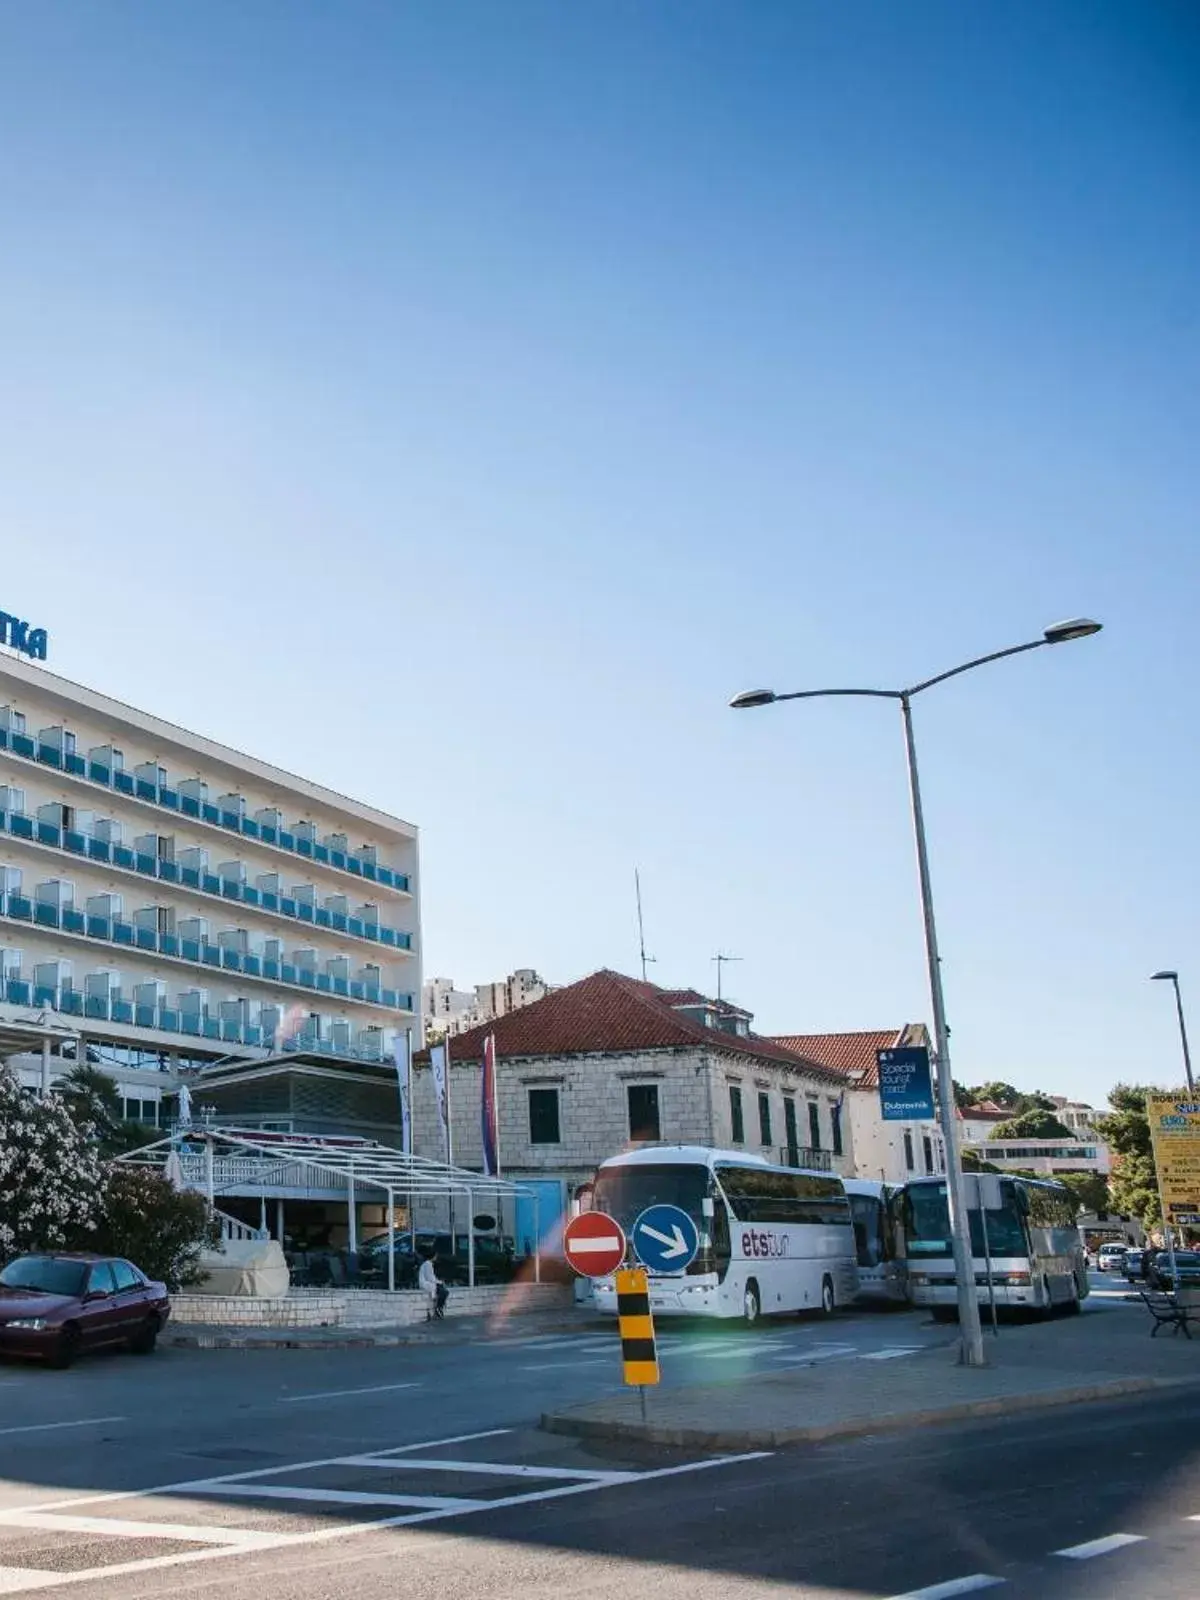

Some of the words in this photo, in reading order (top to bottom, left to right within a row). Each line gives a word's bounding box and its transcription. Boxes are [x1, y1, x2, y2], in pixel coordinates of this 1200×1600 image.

[881, 1062, 916, 1074] Special
[882, 1074, 911, 1084] tourist
[884, 1101, 928, 1110] Dubrovnik
